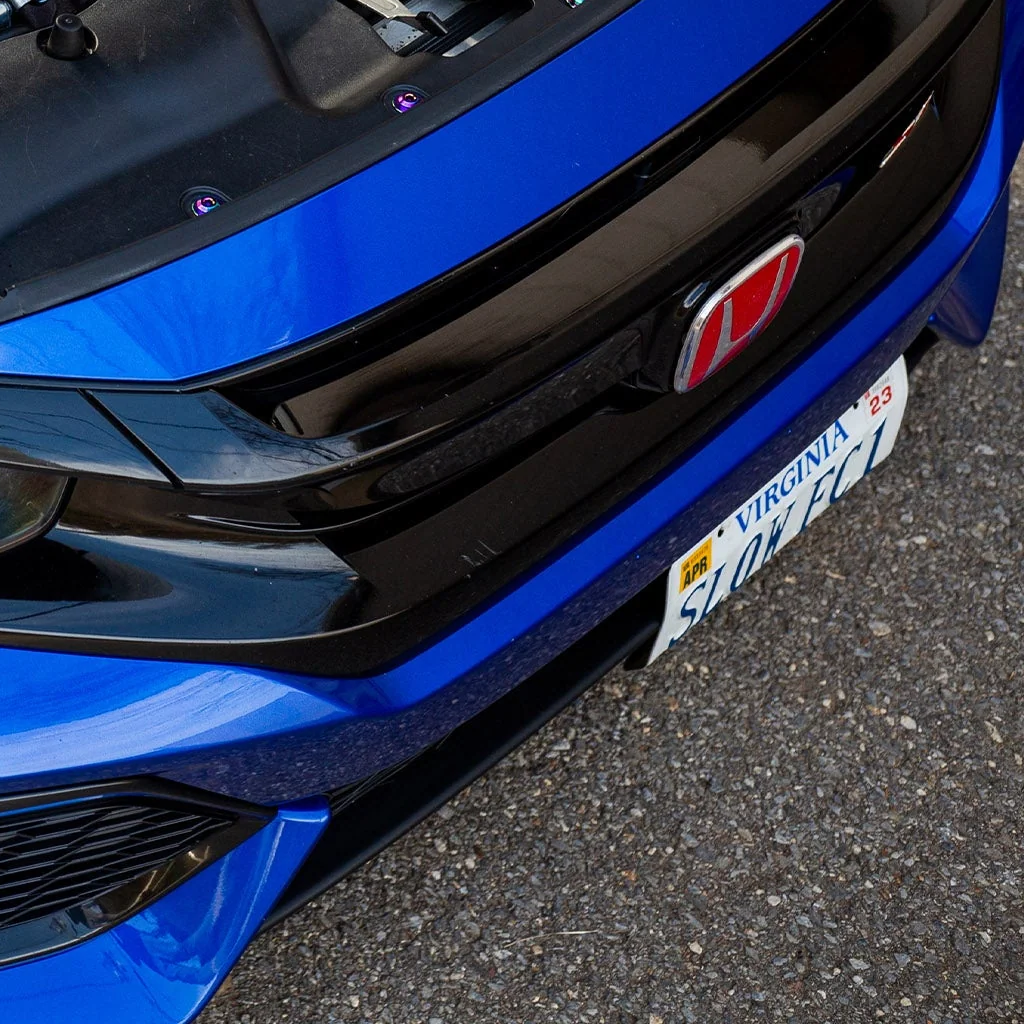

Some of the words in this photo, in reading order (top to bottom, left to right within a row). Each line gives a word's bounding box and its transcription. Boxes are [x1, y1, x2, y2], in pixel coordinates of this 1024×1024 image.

[869, 385, 893, 416] 23
[735, 419, 849, 533] VIRGINIA
[668, 500, 796, 648] SLOW
[683, 556, 708, 590] APR
